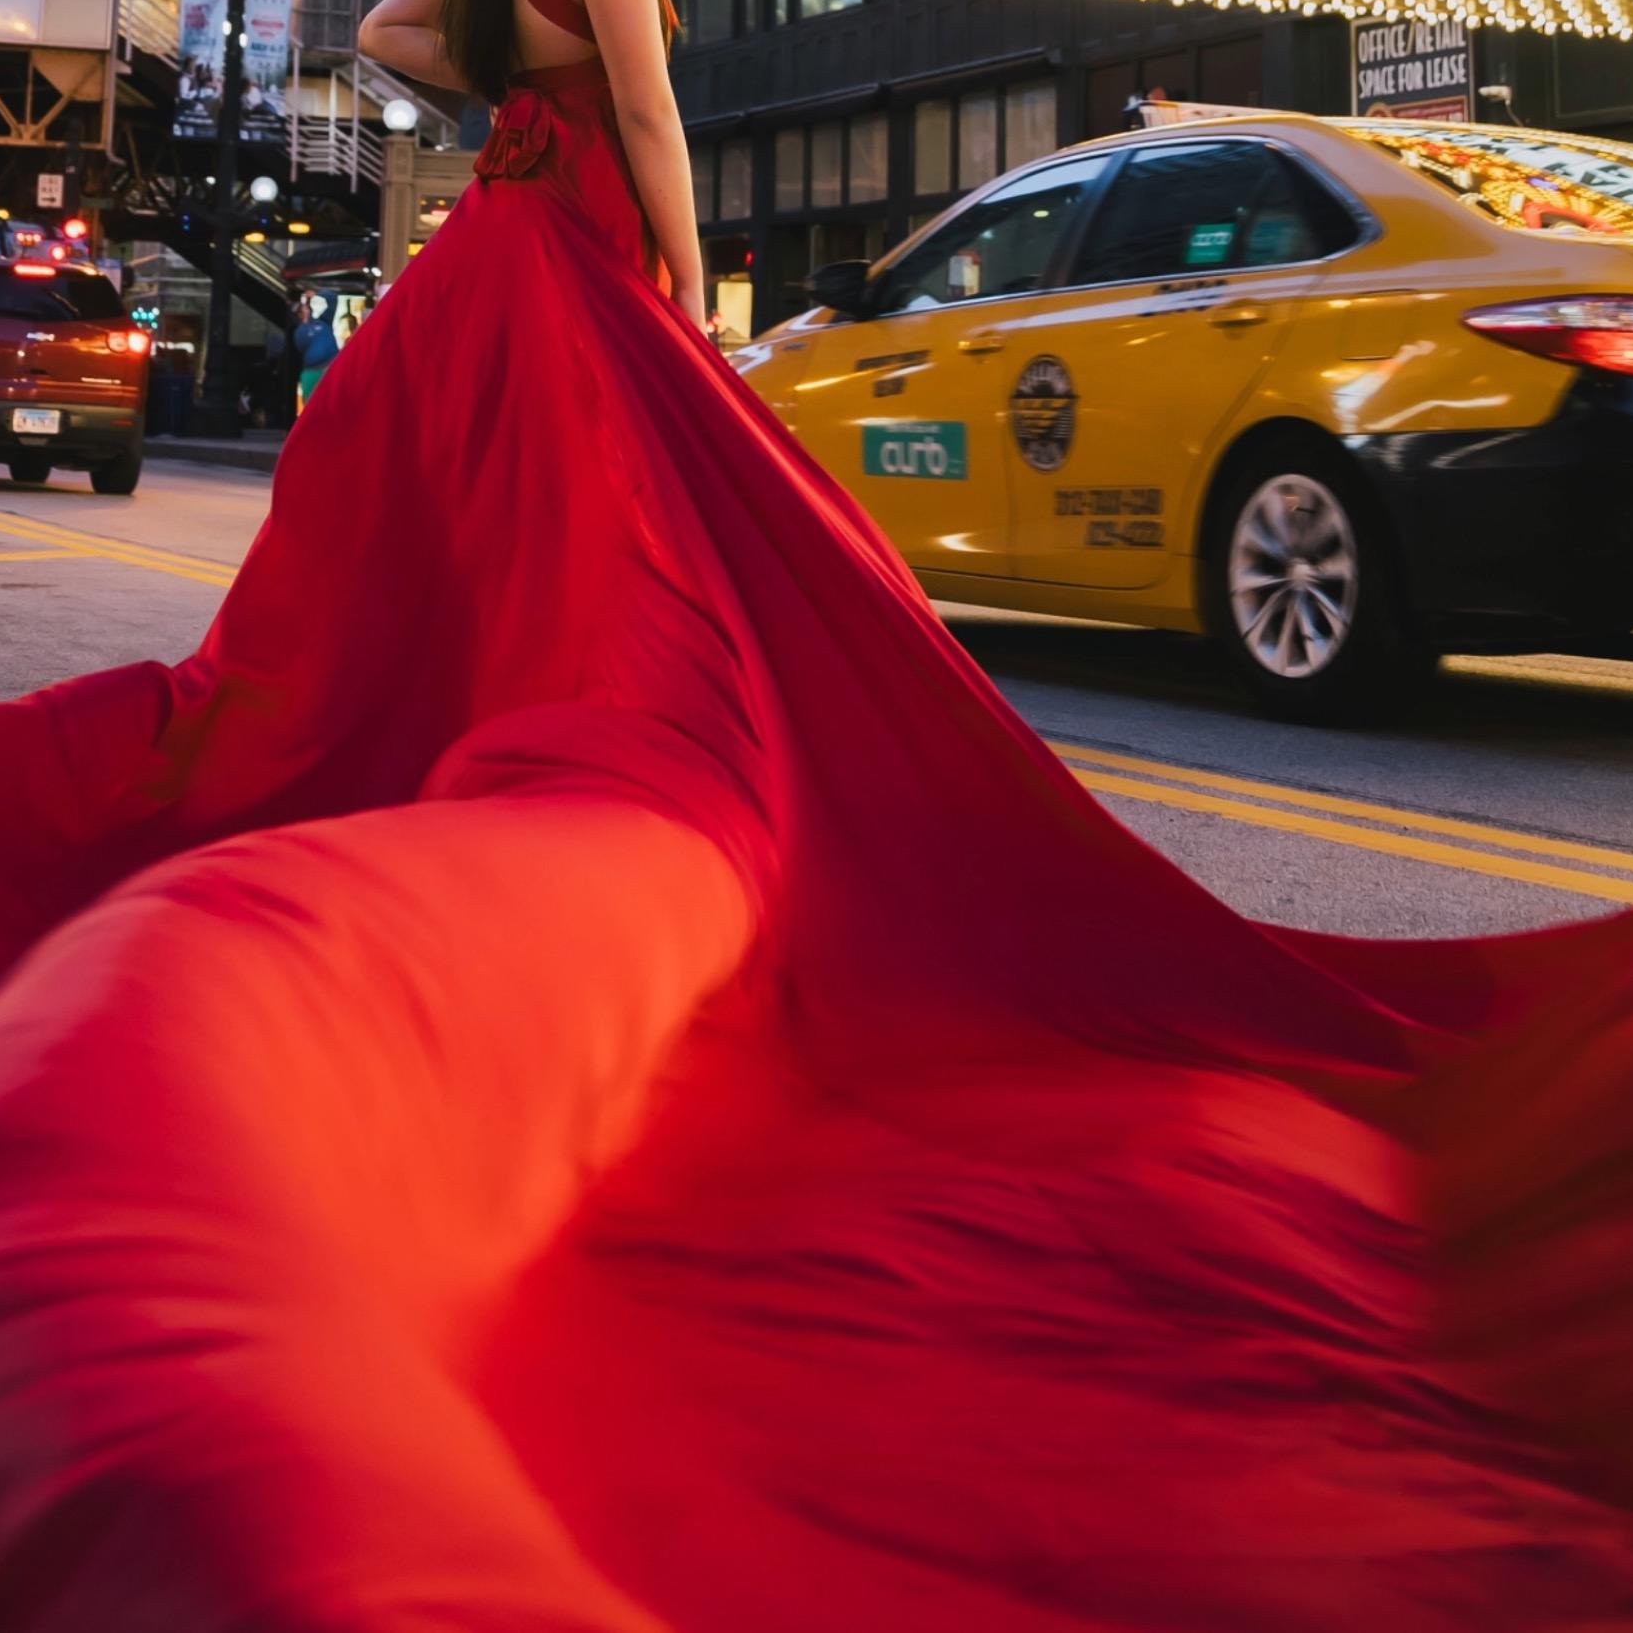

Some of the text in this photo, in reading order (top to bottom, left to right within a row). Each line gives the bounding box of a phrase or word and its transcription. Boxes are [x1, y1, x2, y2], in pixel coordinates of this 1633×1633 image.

[1358, 19, 1466, 64] OFFICE/RETAIL
[1358, 54, 1466, 99] SPACE FOR LEASE
[880, 436, 949, 476] curb
